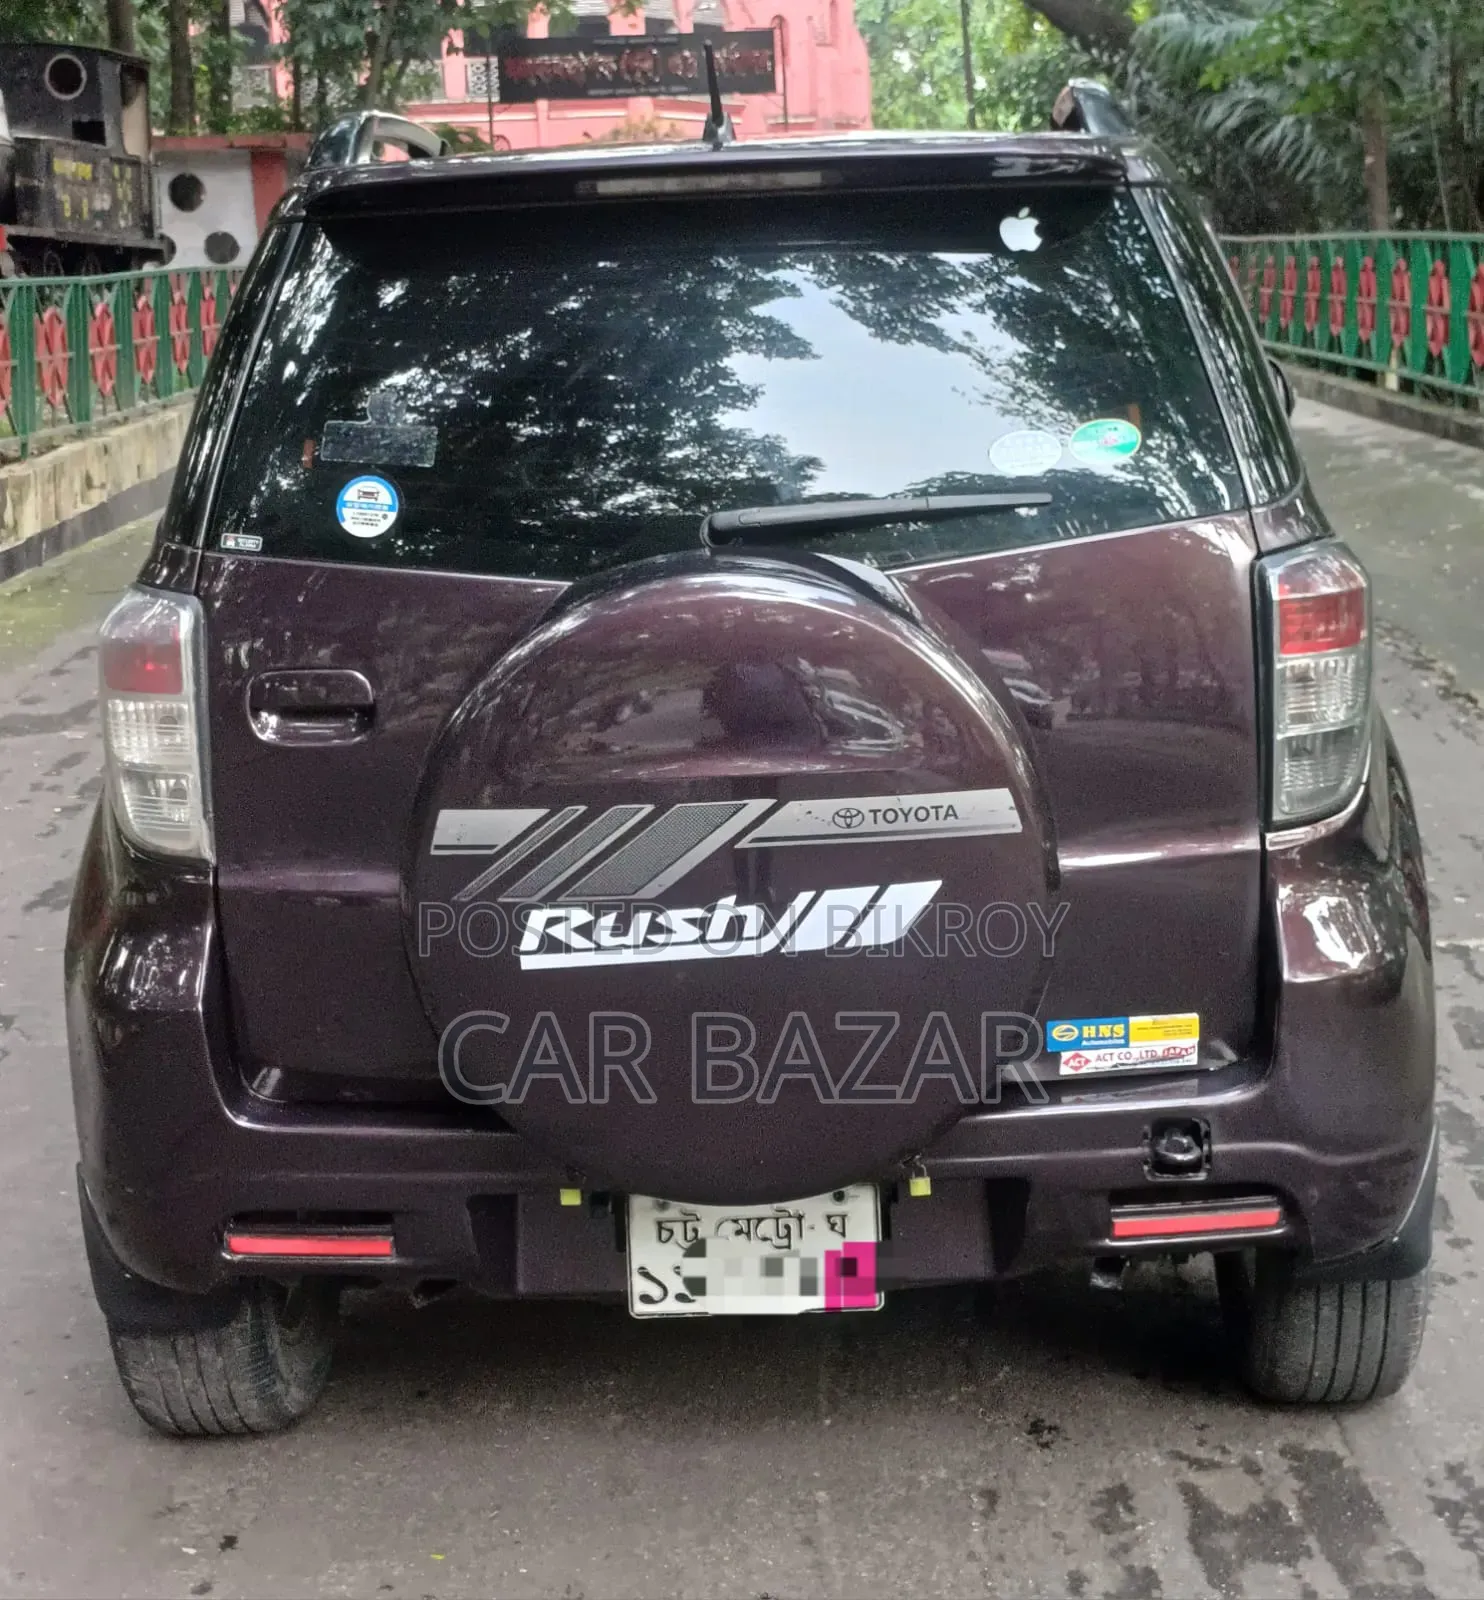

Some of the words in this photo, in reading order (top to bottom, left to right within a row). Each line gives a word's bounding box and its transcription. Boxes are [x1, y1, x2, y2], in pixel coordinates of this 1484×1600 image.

[869, 804, 959, 825] TOYOTA
[519, 894, 766, 951] Rush
[1082, 1024, 1124, 1038] HNS
[1068, 1057, 1086, 1068] ACT
[1096, 1052, 1114, 1062] ACT
